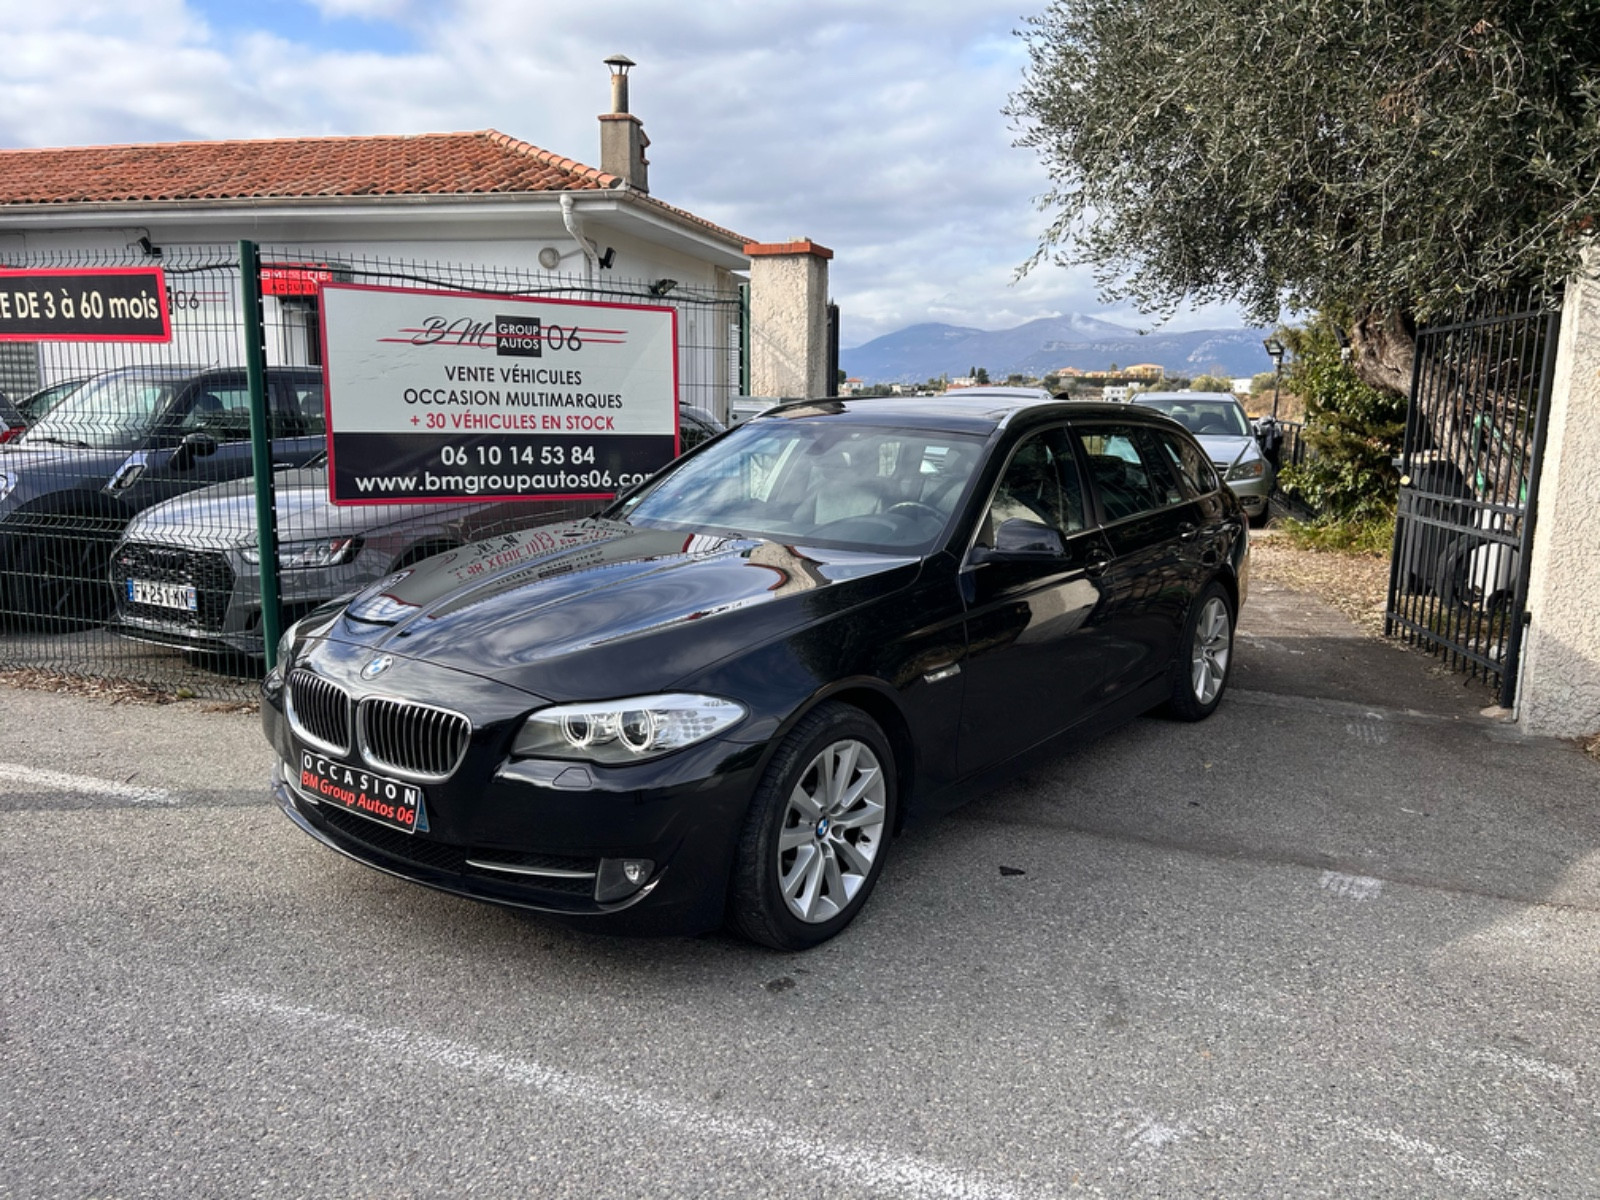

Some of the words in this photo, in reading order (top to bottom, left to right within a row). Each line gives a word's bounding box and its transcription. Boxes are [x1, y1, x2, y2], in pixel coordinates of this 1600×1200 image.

[0, 291, 12, 319] E
[14, 291, 41, 319] DE
[44, 291, 56, 319] 3
[61, 288, 75, 319] à
[80, 291, 104, 319] 60
[109, 290, 158, 319] mois
[175, 290, 200, 310] 06
[411, 316, 492, 350] BM
[547, 324, 582, 352] 06
[498, 323, 539, 336] GROUP
[499, 338, 540, 350] AUTOS
[445, 366, 495, 382] VENTE
[500, 364, 582, 385] VÉHICULES
[403, 388, 500, 406] OCCASION
[505, 392, 623, 409] MULTIMARQUES
[410, 415, 420, 426] +
[426, 413, 446, 429] 30
[451, 409, 537, 430] VÉHICULES
[542, 415, 561, 430] EN
[566, 415, 614, 430] STOCK
[441, 446, 468, 465] 06
[477, 446, 501, 465] 10
[509, 446, 534, 465] 14
[540, 446, 565, 465] 53
[571, 446, 595, 465] 84
[304, 755, 415, 805] OCCASION
[302, 771, 318, 790] BM
[320, 780, 356, 806] Group
[357, 793, 394, 818] Autos
[396, 807, 415, 825] 06
